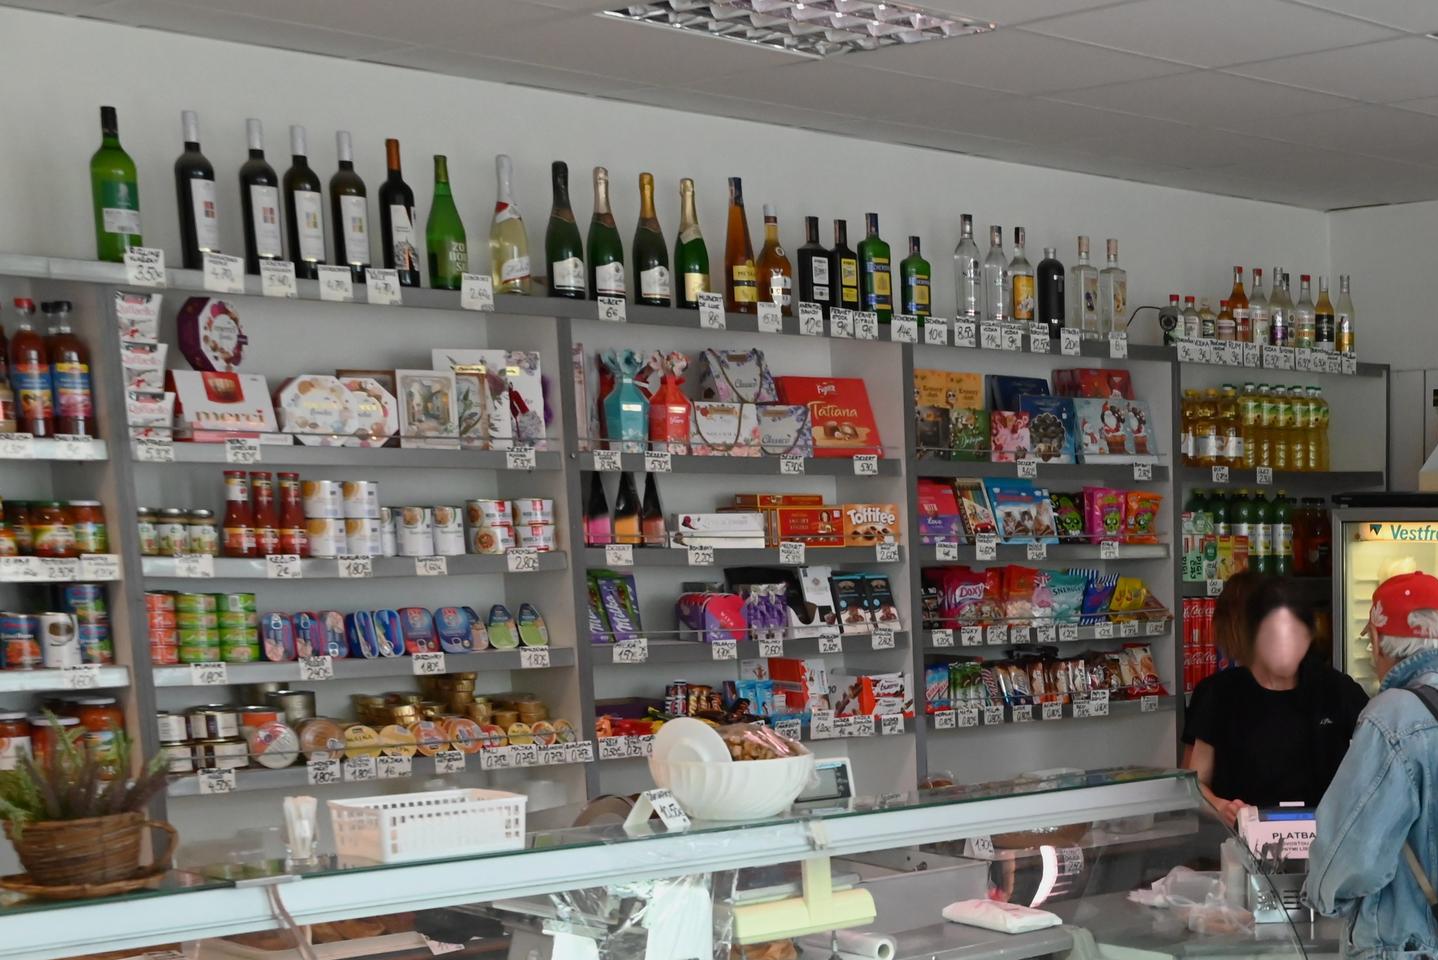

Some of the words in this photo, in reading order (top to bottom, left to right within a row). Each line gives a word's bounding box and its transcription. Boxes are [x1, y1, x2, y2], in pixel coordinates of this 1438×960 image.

[195, 409, 265, 424] merci
[807, 400, 859, 419] Tatiana
[846, 506, 896, 526] Toffifee
[605, 593, 633, 633] Milka
[1272, 831, 1317, 841] PLATBA
